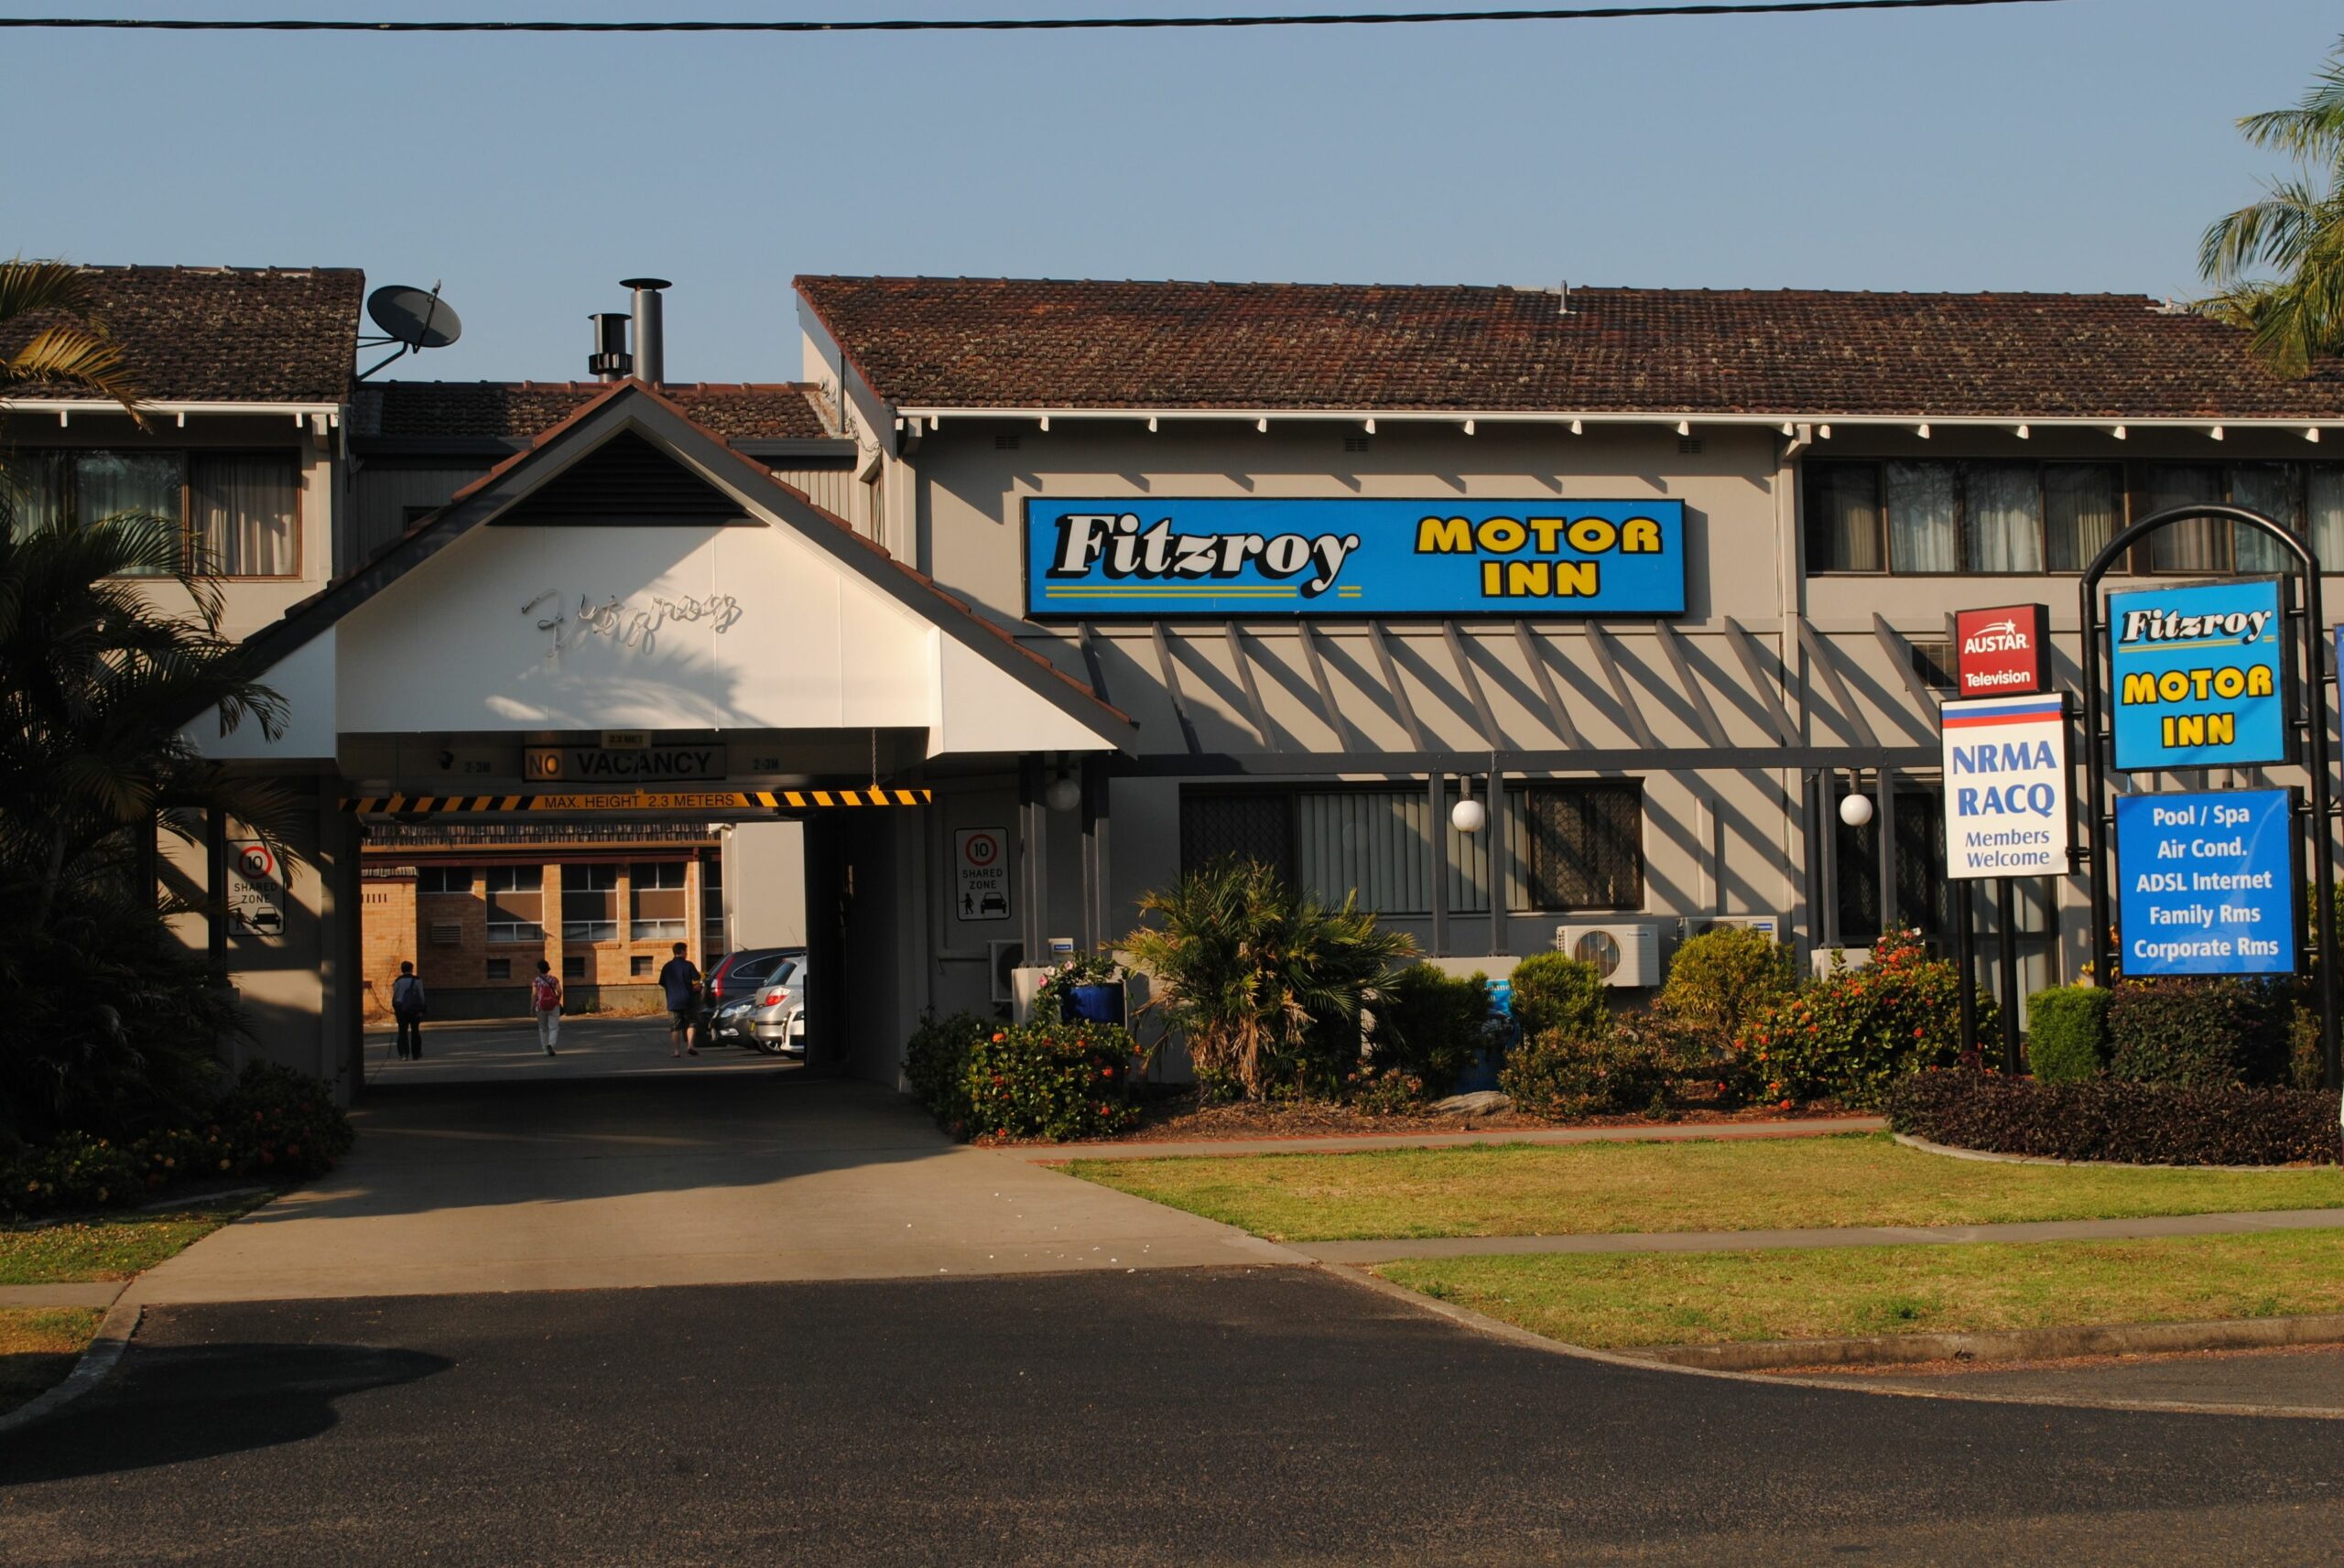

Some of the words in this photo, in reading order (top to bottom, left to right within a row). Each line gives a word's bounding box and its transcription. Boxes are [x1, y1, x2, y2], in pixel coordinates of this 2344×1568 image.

[1414, 515, 1664, 555] MOTOR
[1046, 513, 1361, 598] Fitzroy
[1480, 559, 1601, 598] INN
[2119, 609, 2273, 644] Fitzroy
[1965, 669, 2031, 687] Television
[2122, 664, 2274, 706] MOTOR
[2162, 712, 2235, 749] INN
[528, 753, 560, 776] NO
[576, 752, 712, 775] VACANCY
[1952, 741, 2057, 774] NRMA
[544, 797, 581, 808] MAX.
[585, 795, 641, 807] HEIGHT
[647, 795, 669, 807] 2.3
[674, 794, 735, 807] METERS
[1958, 783, 2056, 818] RACQ
[2153, 806, 2195, 827] Pool
[2200, 806, 2208, 827] /
[2213, 805, 2250, 828] Spa
[1965, 828, 2050, 848] Members
[2157, 838, 2187, 859] Air
[2191, 837, 2248, 858] Cond.
[974, 842, 989, 857] 10
[1967, 850, 2050, 868] Welcome
[248, 855, 263, 871] 10
[961, 868, 1004, 879] SHARED
[233, 882, 277, 892] SHARED
[969, 880, 997, 890] ZONE
[2136, 872, 2187, 892] ADSL
[2192, 871, 2273, 891] Internet
[241, 894, 272, 904] ZONE
[2149, 904, 2214, 928] Family
[2219, 904, 2262, 923] Rms
[2134, 939, 2231, 962] Corporate
[2237, 937, 2279, 955] Rms
